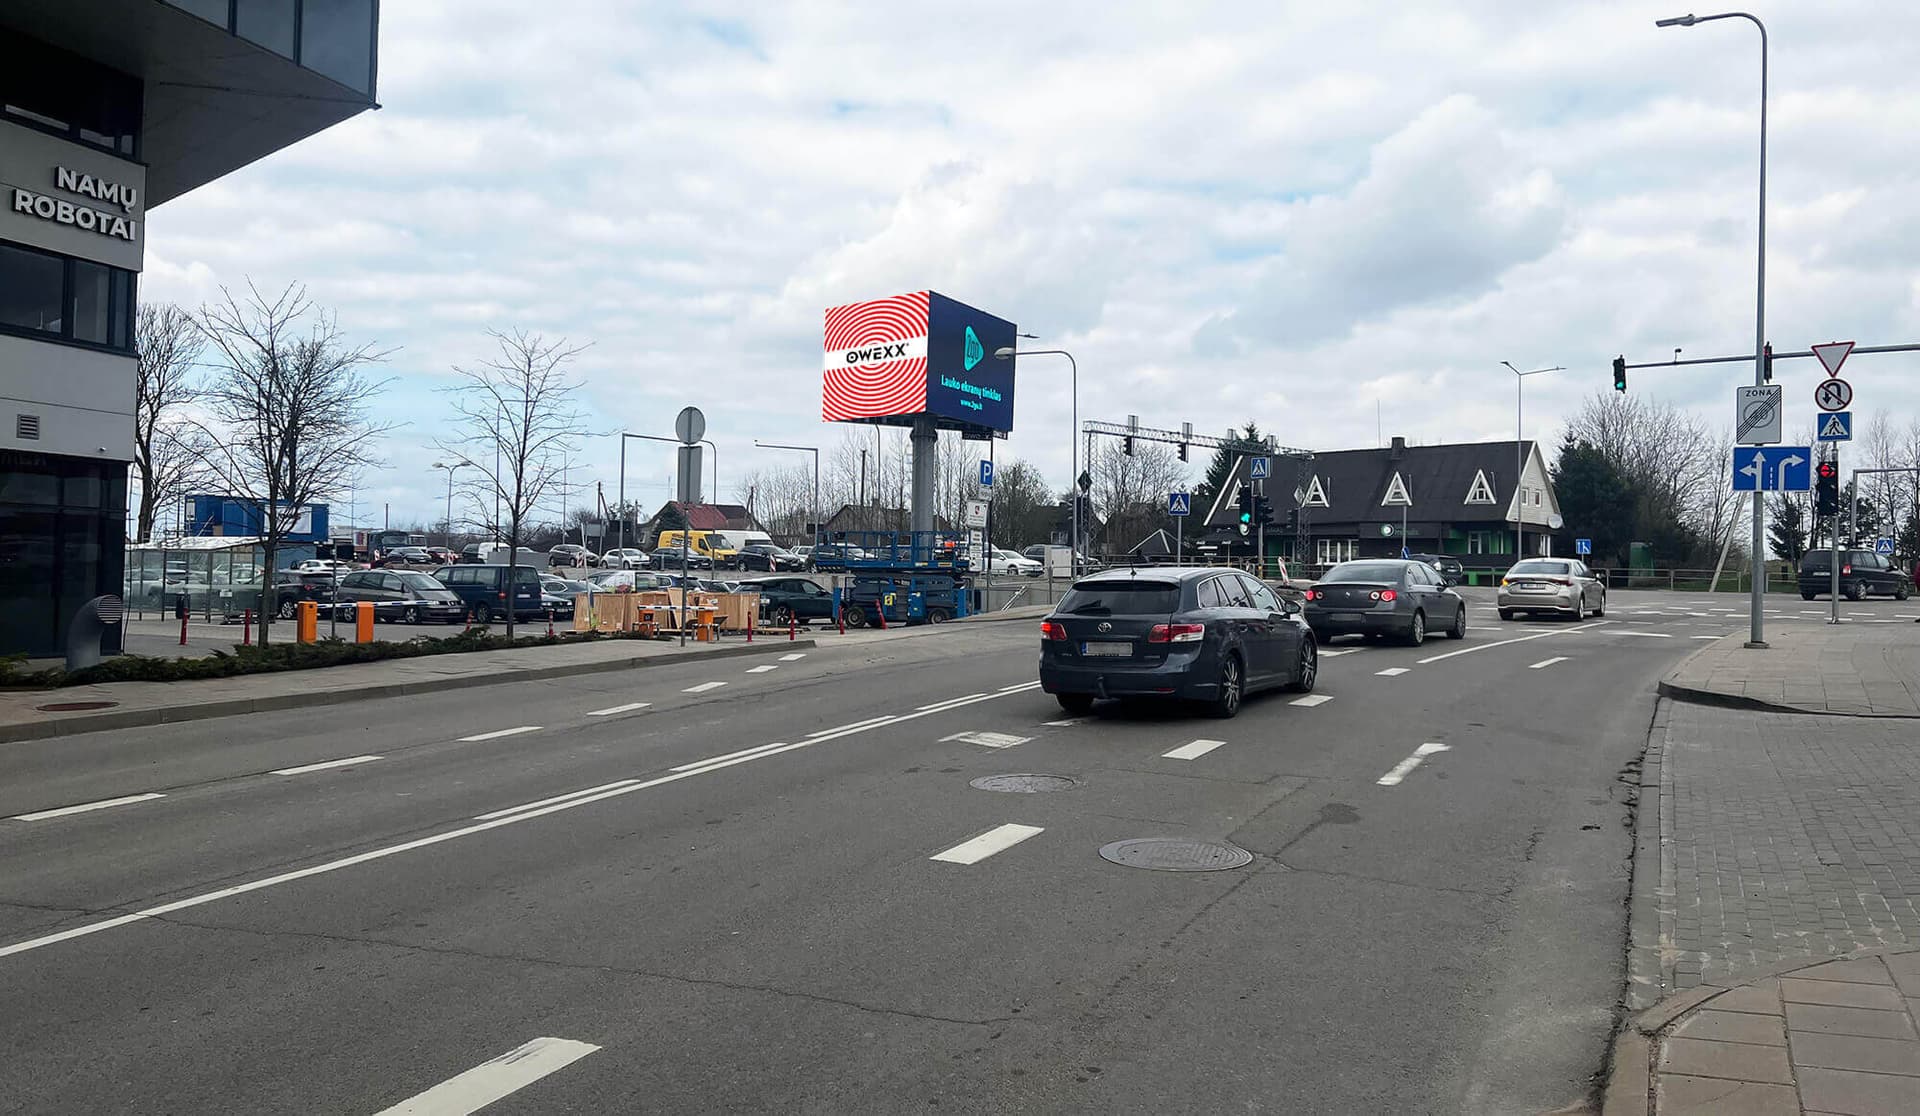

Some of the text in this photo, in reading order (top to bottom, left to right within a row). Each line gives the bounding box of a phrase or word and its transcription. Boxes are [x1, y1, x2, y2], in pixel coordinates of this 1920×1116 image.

[57, 166, 137, 213] NAMŲ
[15, 188, 136, 240] ROBOTAI
[1745, 389, 1772, 397] ZONA
